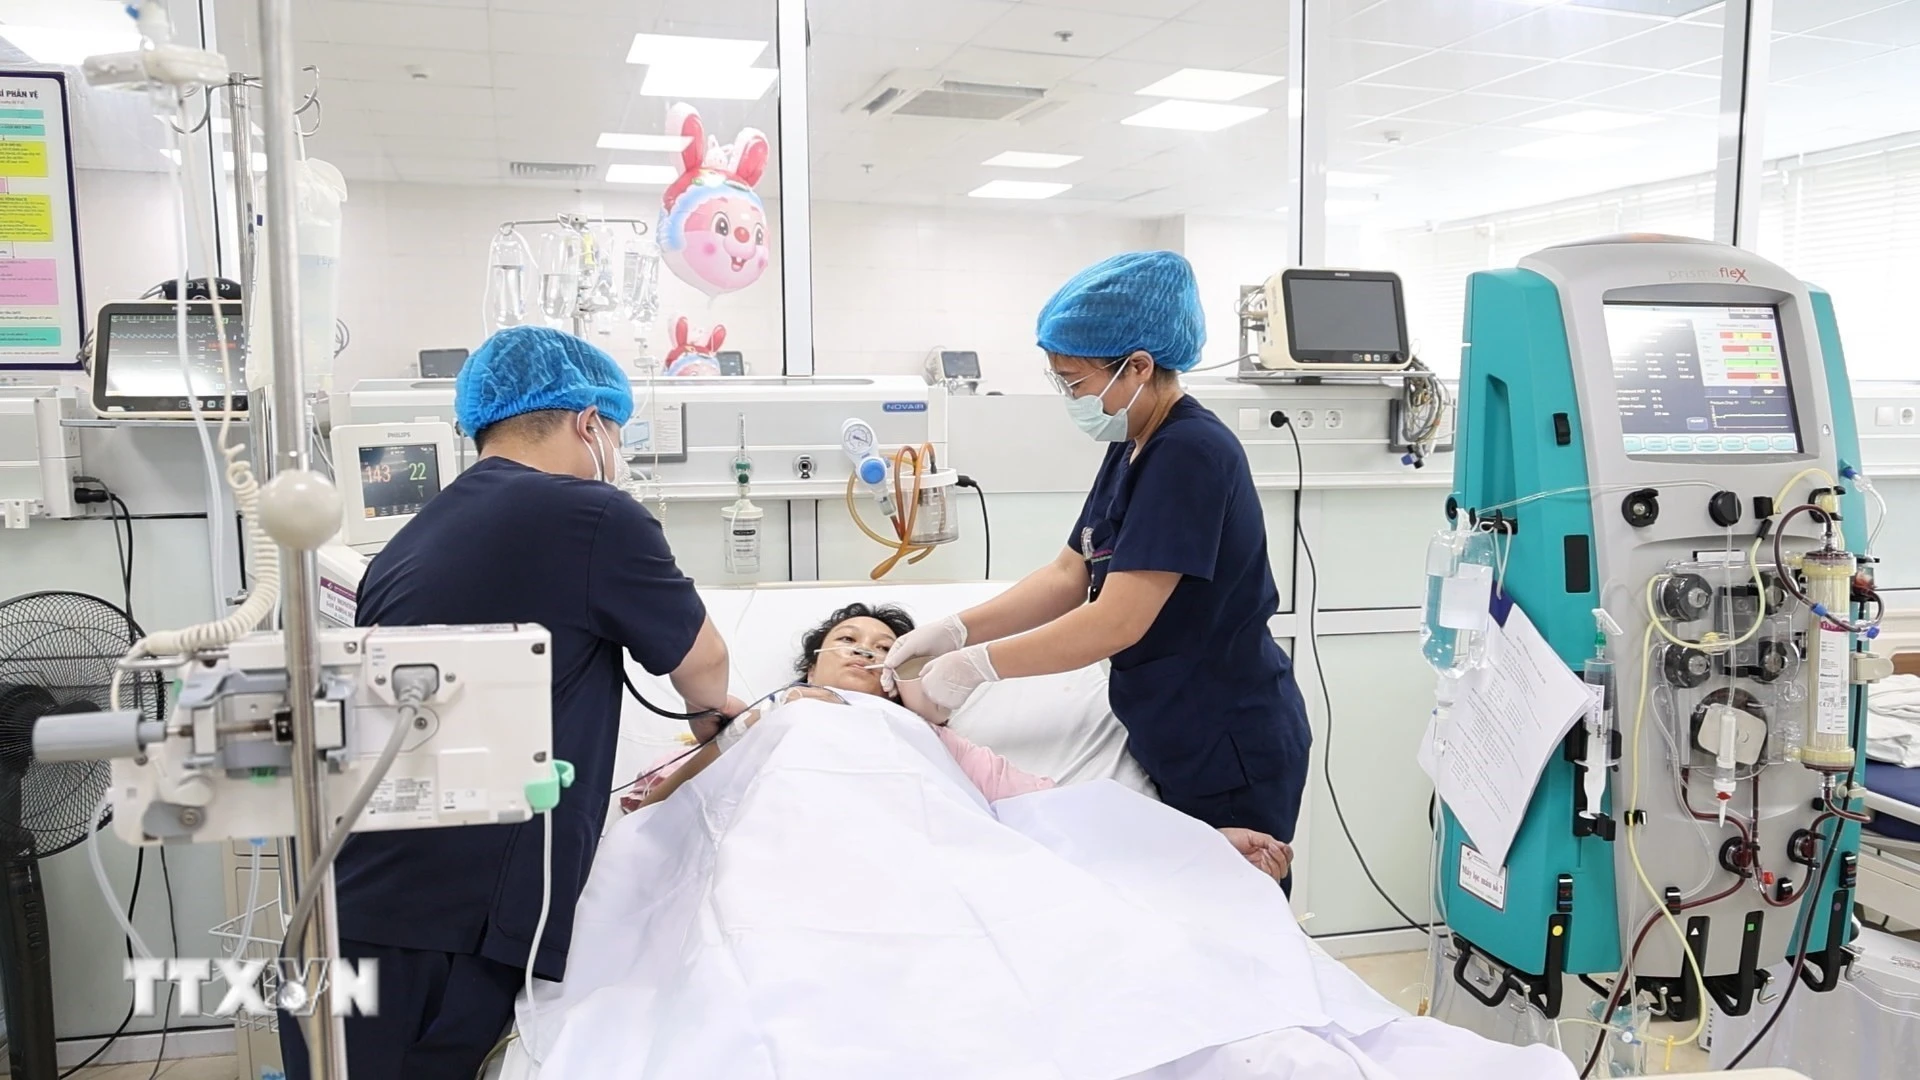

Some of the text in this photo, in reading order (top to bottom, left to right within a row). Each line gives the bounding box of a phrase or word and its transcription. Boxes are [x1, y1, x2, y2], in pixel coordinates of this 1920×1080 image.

[6, 88, 27, 98] PHẢN
[29, 89, 38, 99] VỆ
[886, 403, 925, 411] NOVAIR
[387, 431, 412, 439] PHILIPS
[365, 462, 427, 484] 143 22
